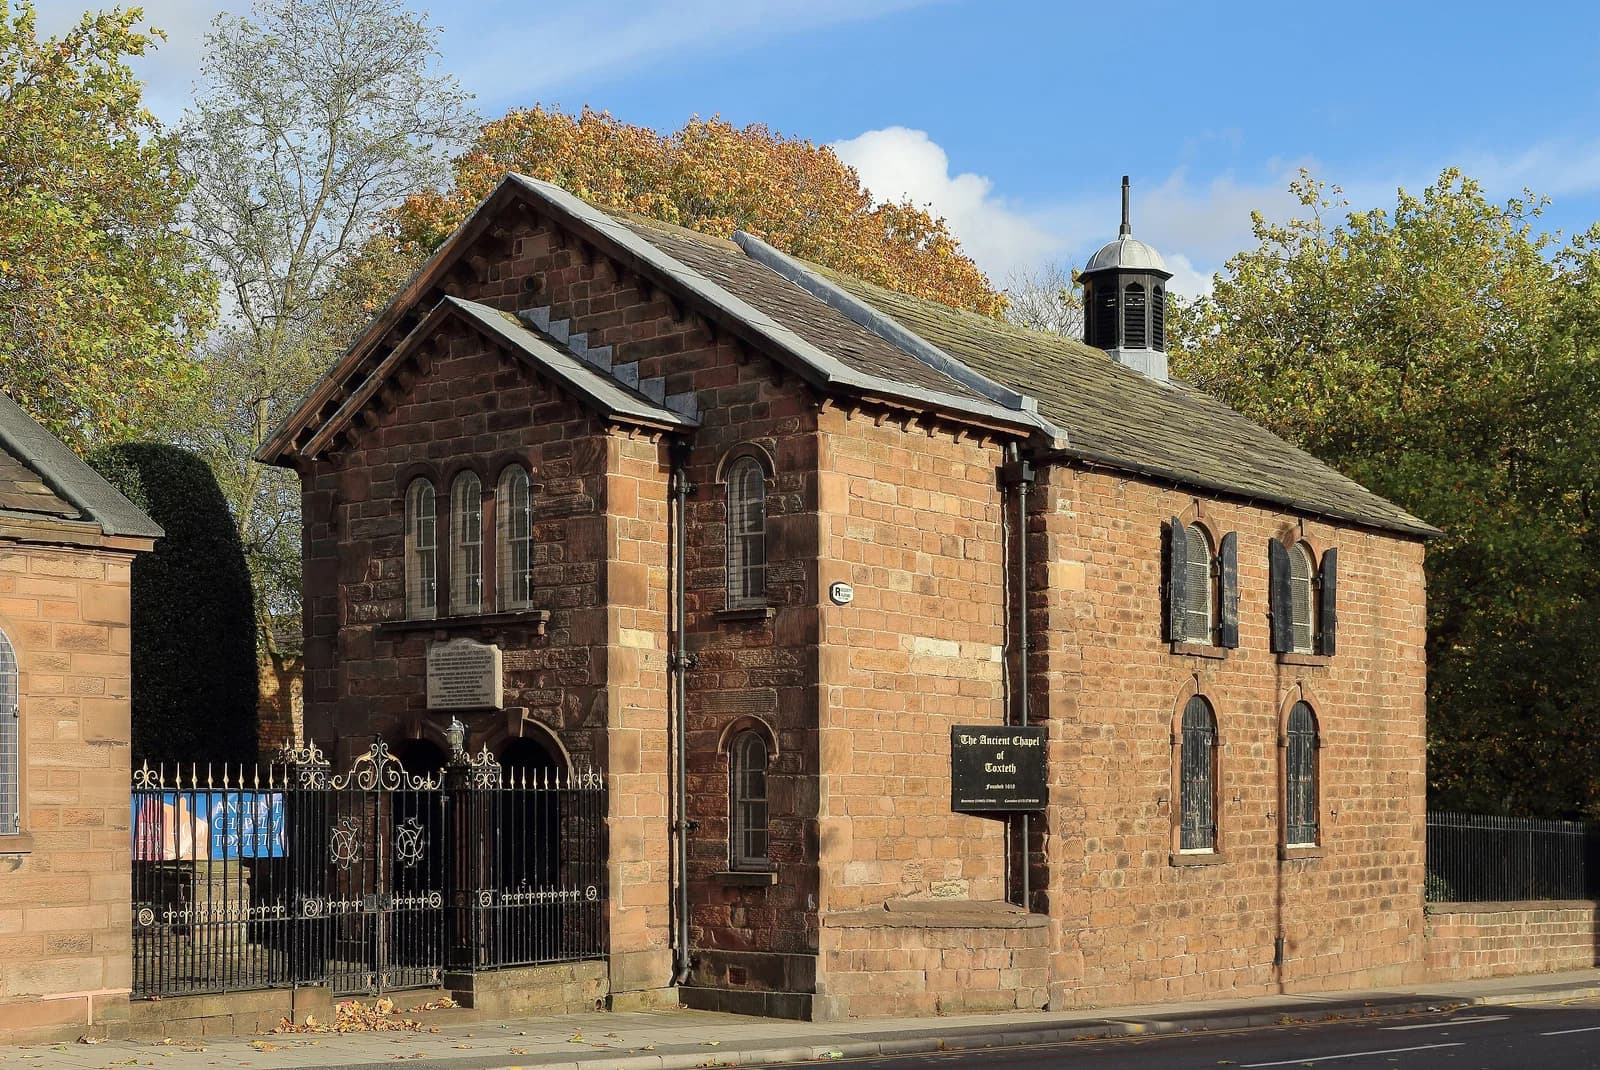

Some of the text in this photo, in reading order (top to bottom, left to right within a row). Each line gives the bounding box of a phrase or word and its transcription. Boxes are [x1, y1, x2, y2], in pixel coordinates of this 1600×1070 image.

[959, 735, 1040, 747] The Ancient Chapel
[996, 750, 1005, 760] of
[984, 762, 1017, 774] Toxteth
[215, 817, 269, 830] CHPL
